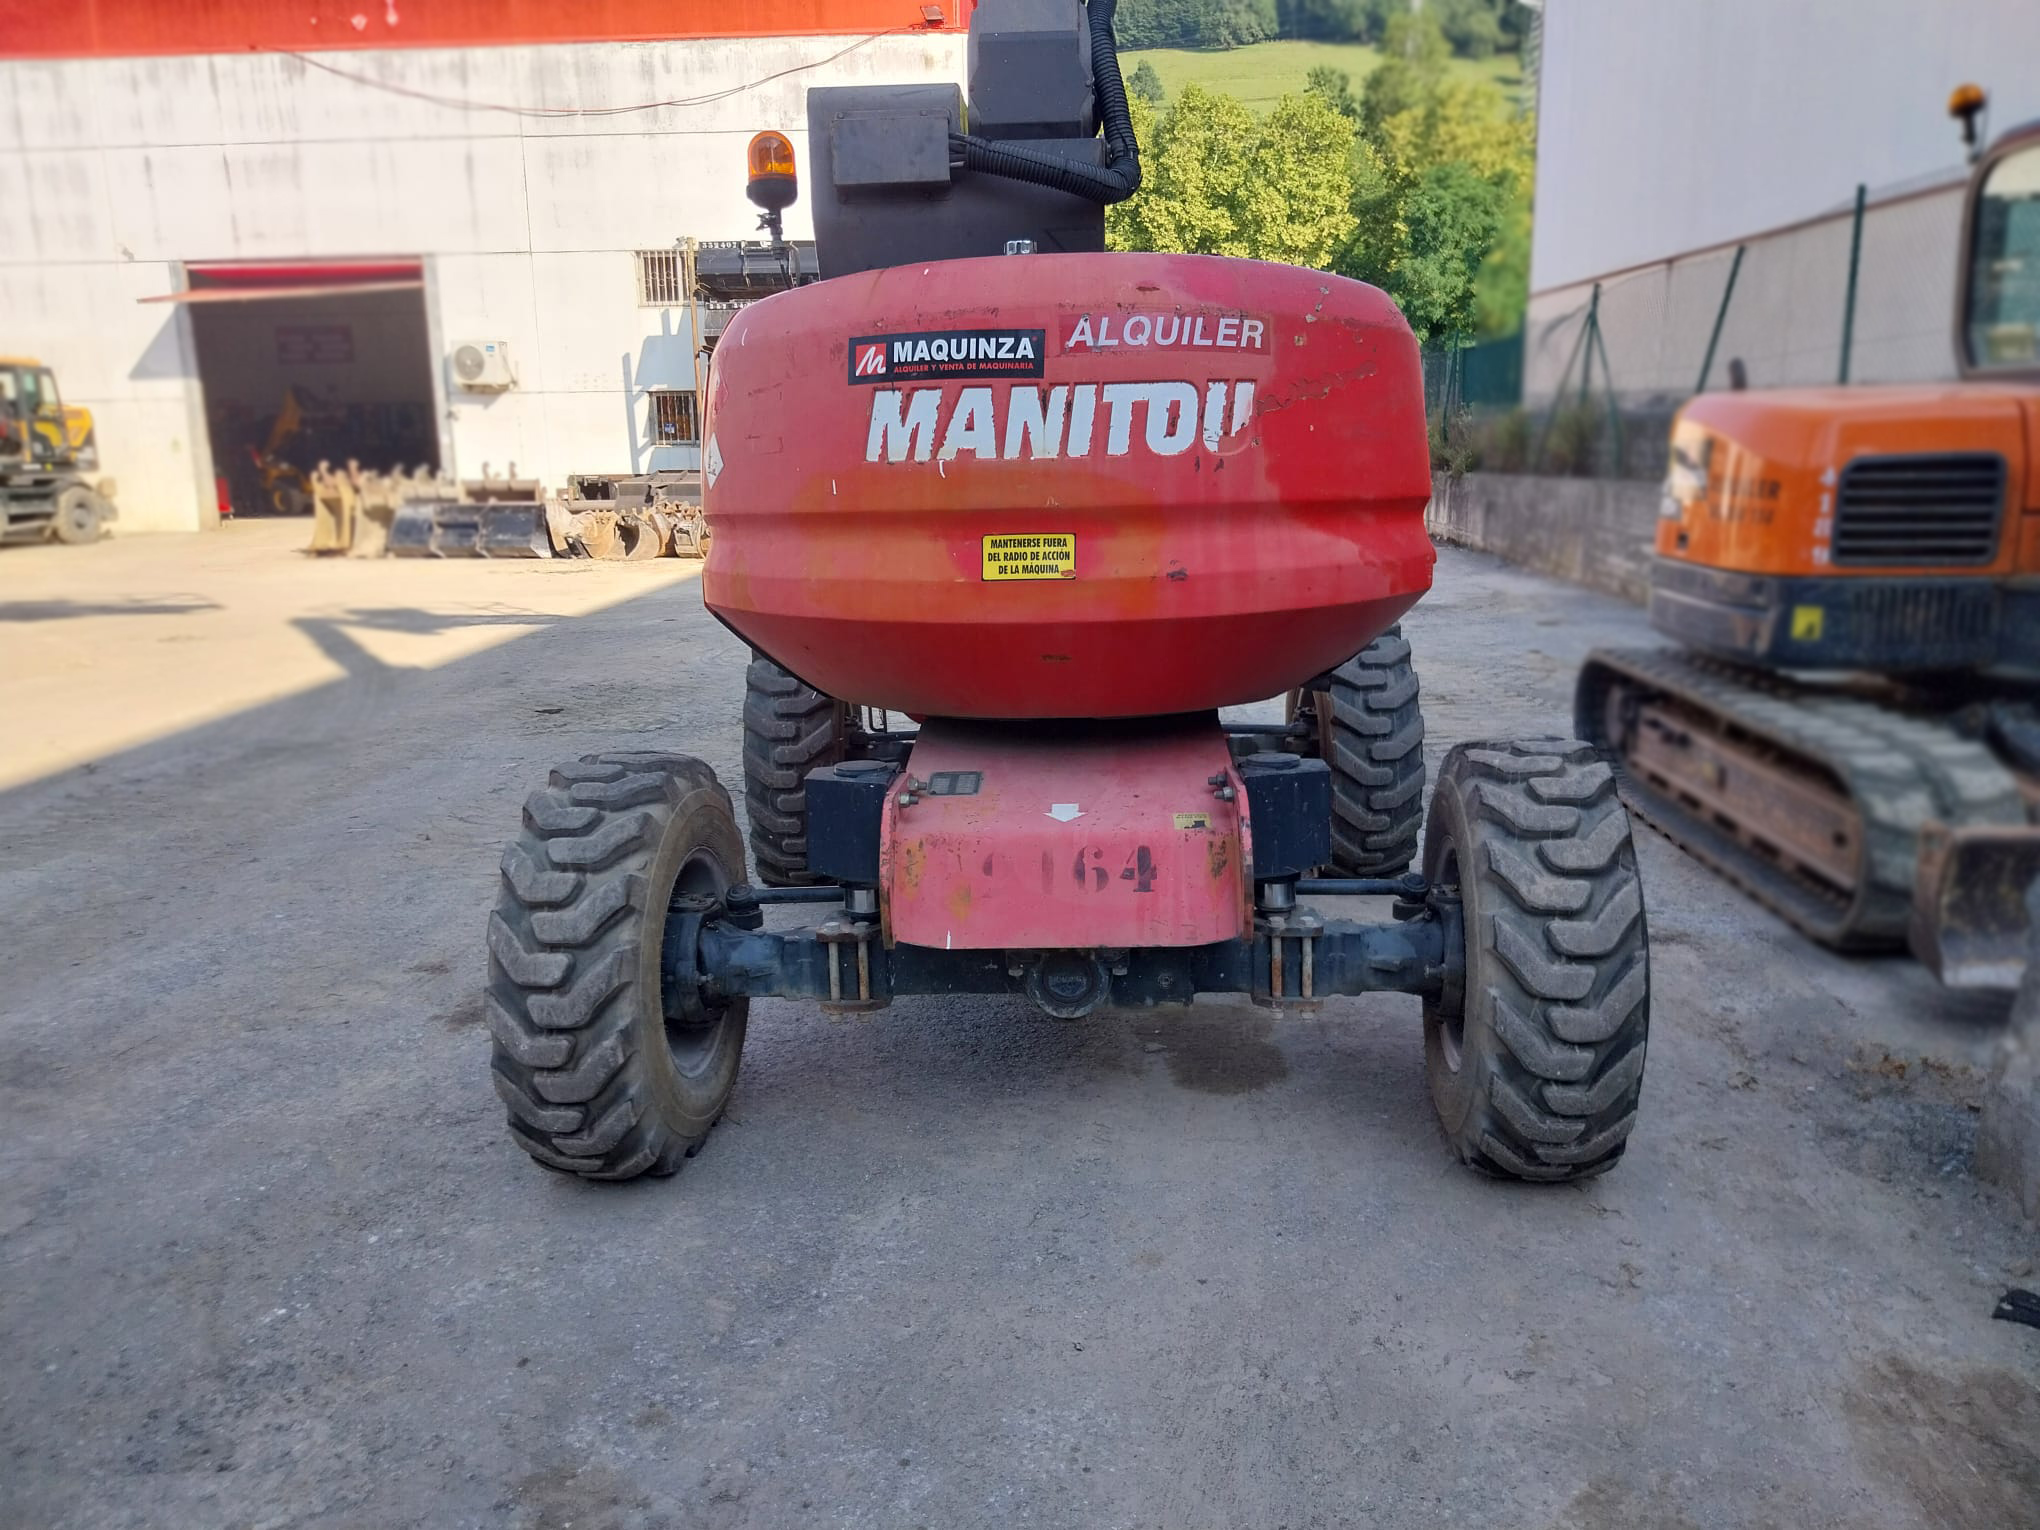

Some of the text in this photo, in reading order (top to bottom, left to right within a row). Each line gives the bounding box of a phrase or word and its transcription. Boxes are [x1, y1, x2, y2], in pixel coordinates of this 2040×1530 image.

[1068, 315, 1264, 349] ALQUILER
[894, 337, 1035, 363] MAQUINZA
[894, 362, 1034, 373] ALQUILER Y VENTA DE MAQUINARIA
[865, 382, 1255, 462] MANITOU
[991, 538, 1067, 549] MANTENERSE FUERA
[988, 549, 1070, 561] DEL RADIO DE ACCIÓN
[998, 562, 1059, 575] DE LA MÁQUINA
